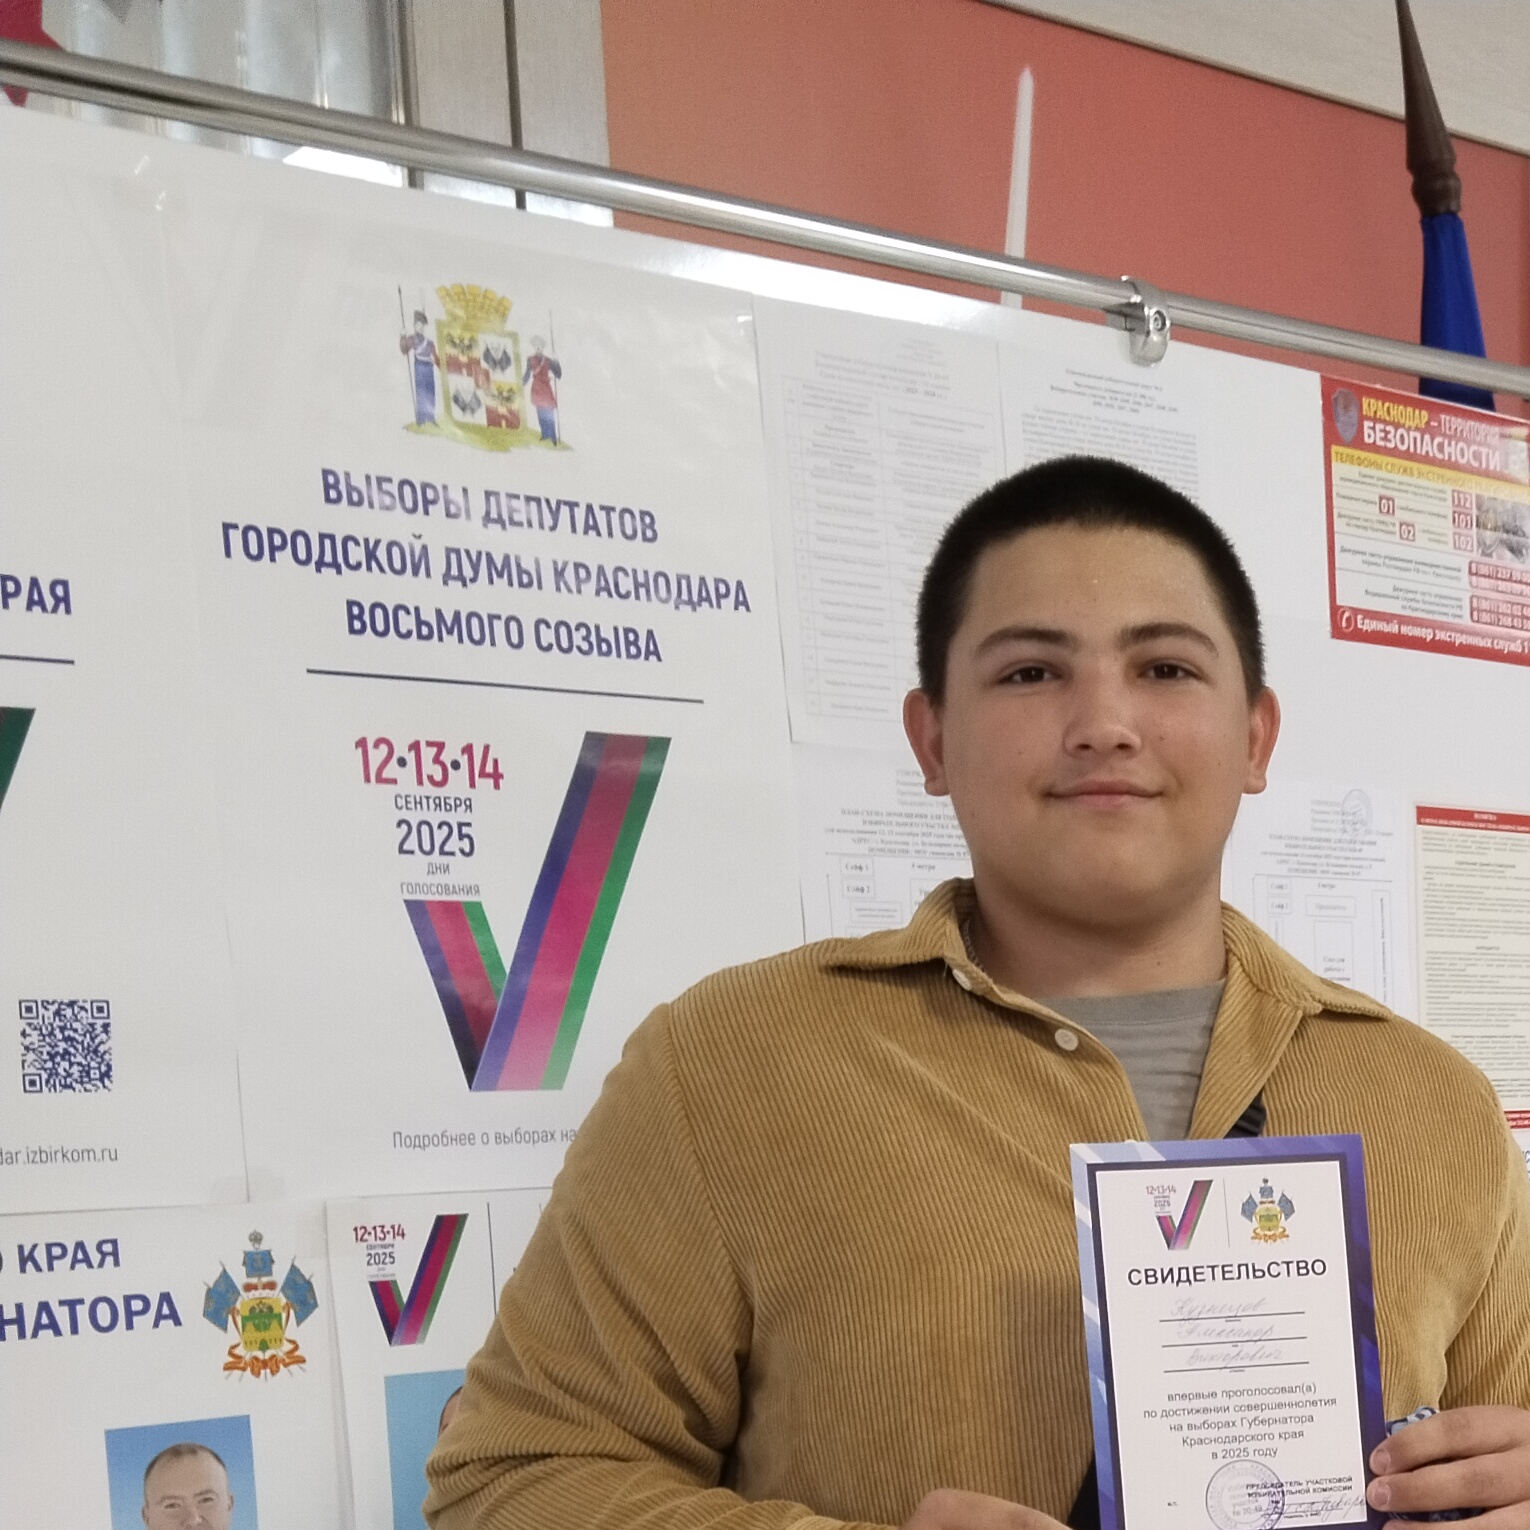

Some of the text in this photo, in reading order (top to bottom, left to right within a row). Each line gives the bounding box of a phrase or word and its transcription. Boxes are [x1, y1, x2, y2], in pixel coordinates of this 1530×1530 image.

[1362, 396, 1429, 429] КРАСНОДАР
[1363, 420, 1500, 471] БЕЗОПАСНОСТИ
[321, 468, 659, 544] ВЫБОРЫ ДЕПУТАТОВ
[1380, 499, 1394, 514] 01
[1453, 512, 1472, 528] 101
[1400, 524, 1414, 540] 02
[222, 521, 752, 613] ГОРОДСКОЙ ДУМЫ КРАСНОДАРА
[0, 574, 72, 615] РАЯ
[346, 598, 663, 663] ВОСЬМОГО СОЗЫВА
[1356, 614, 1399, 634] Единый
[1400, 625, 1434, 643] номер
[1434, 629, 1493, 649] экстренных
[395, 793, 473, 813] СЕНТЯБРЯ
[396, 818, 476, 858] 2025
[426, 862, 451, 876] ДНИ
[400, 882, 481, 896] ГОЛОСОВАНИЯ
[392, 1127, 577, 1152] Подробнее о выборах на
[17, 1238, 121, 1274] КРАЯ
[366, 1251, 396, 1267] 2025
[1127, 1258, 1328, 1287] СВИДЕТЕЛЬСТВО
[0, 1291, 183, 1342] НАТОРА
[1167, 1382, 1317, 1403] впервые проголосовал(а)
[1143, 1397, 1337, 1420] по достижении совершеннолетия
[1169, 1413, 1315, 1434] на выборах Губернатора
[1182, 1428, 1305, 1448] Краснодарского края
[1211, 1447, 1278, 1460] в 2025 году
[1305, 1476, 1352, 1486] УЧАСТКОВОЙ
[1312, 1485, 1352, 1494] КОМИССИИ
